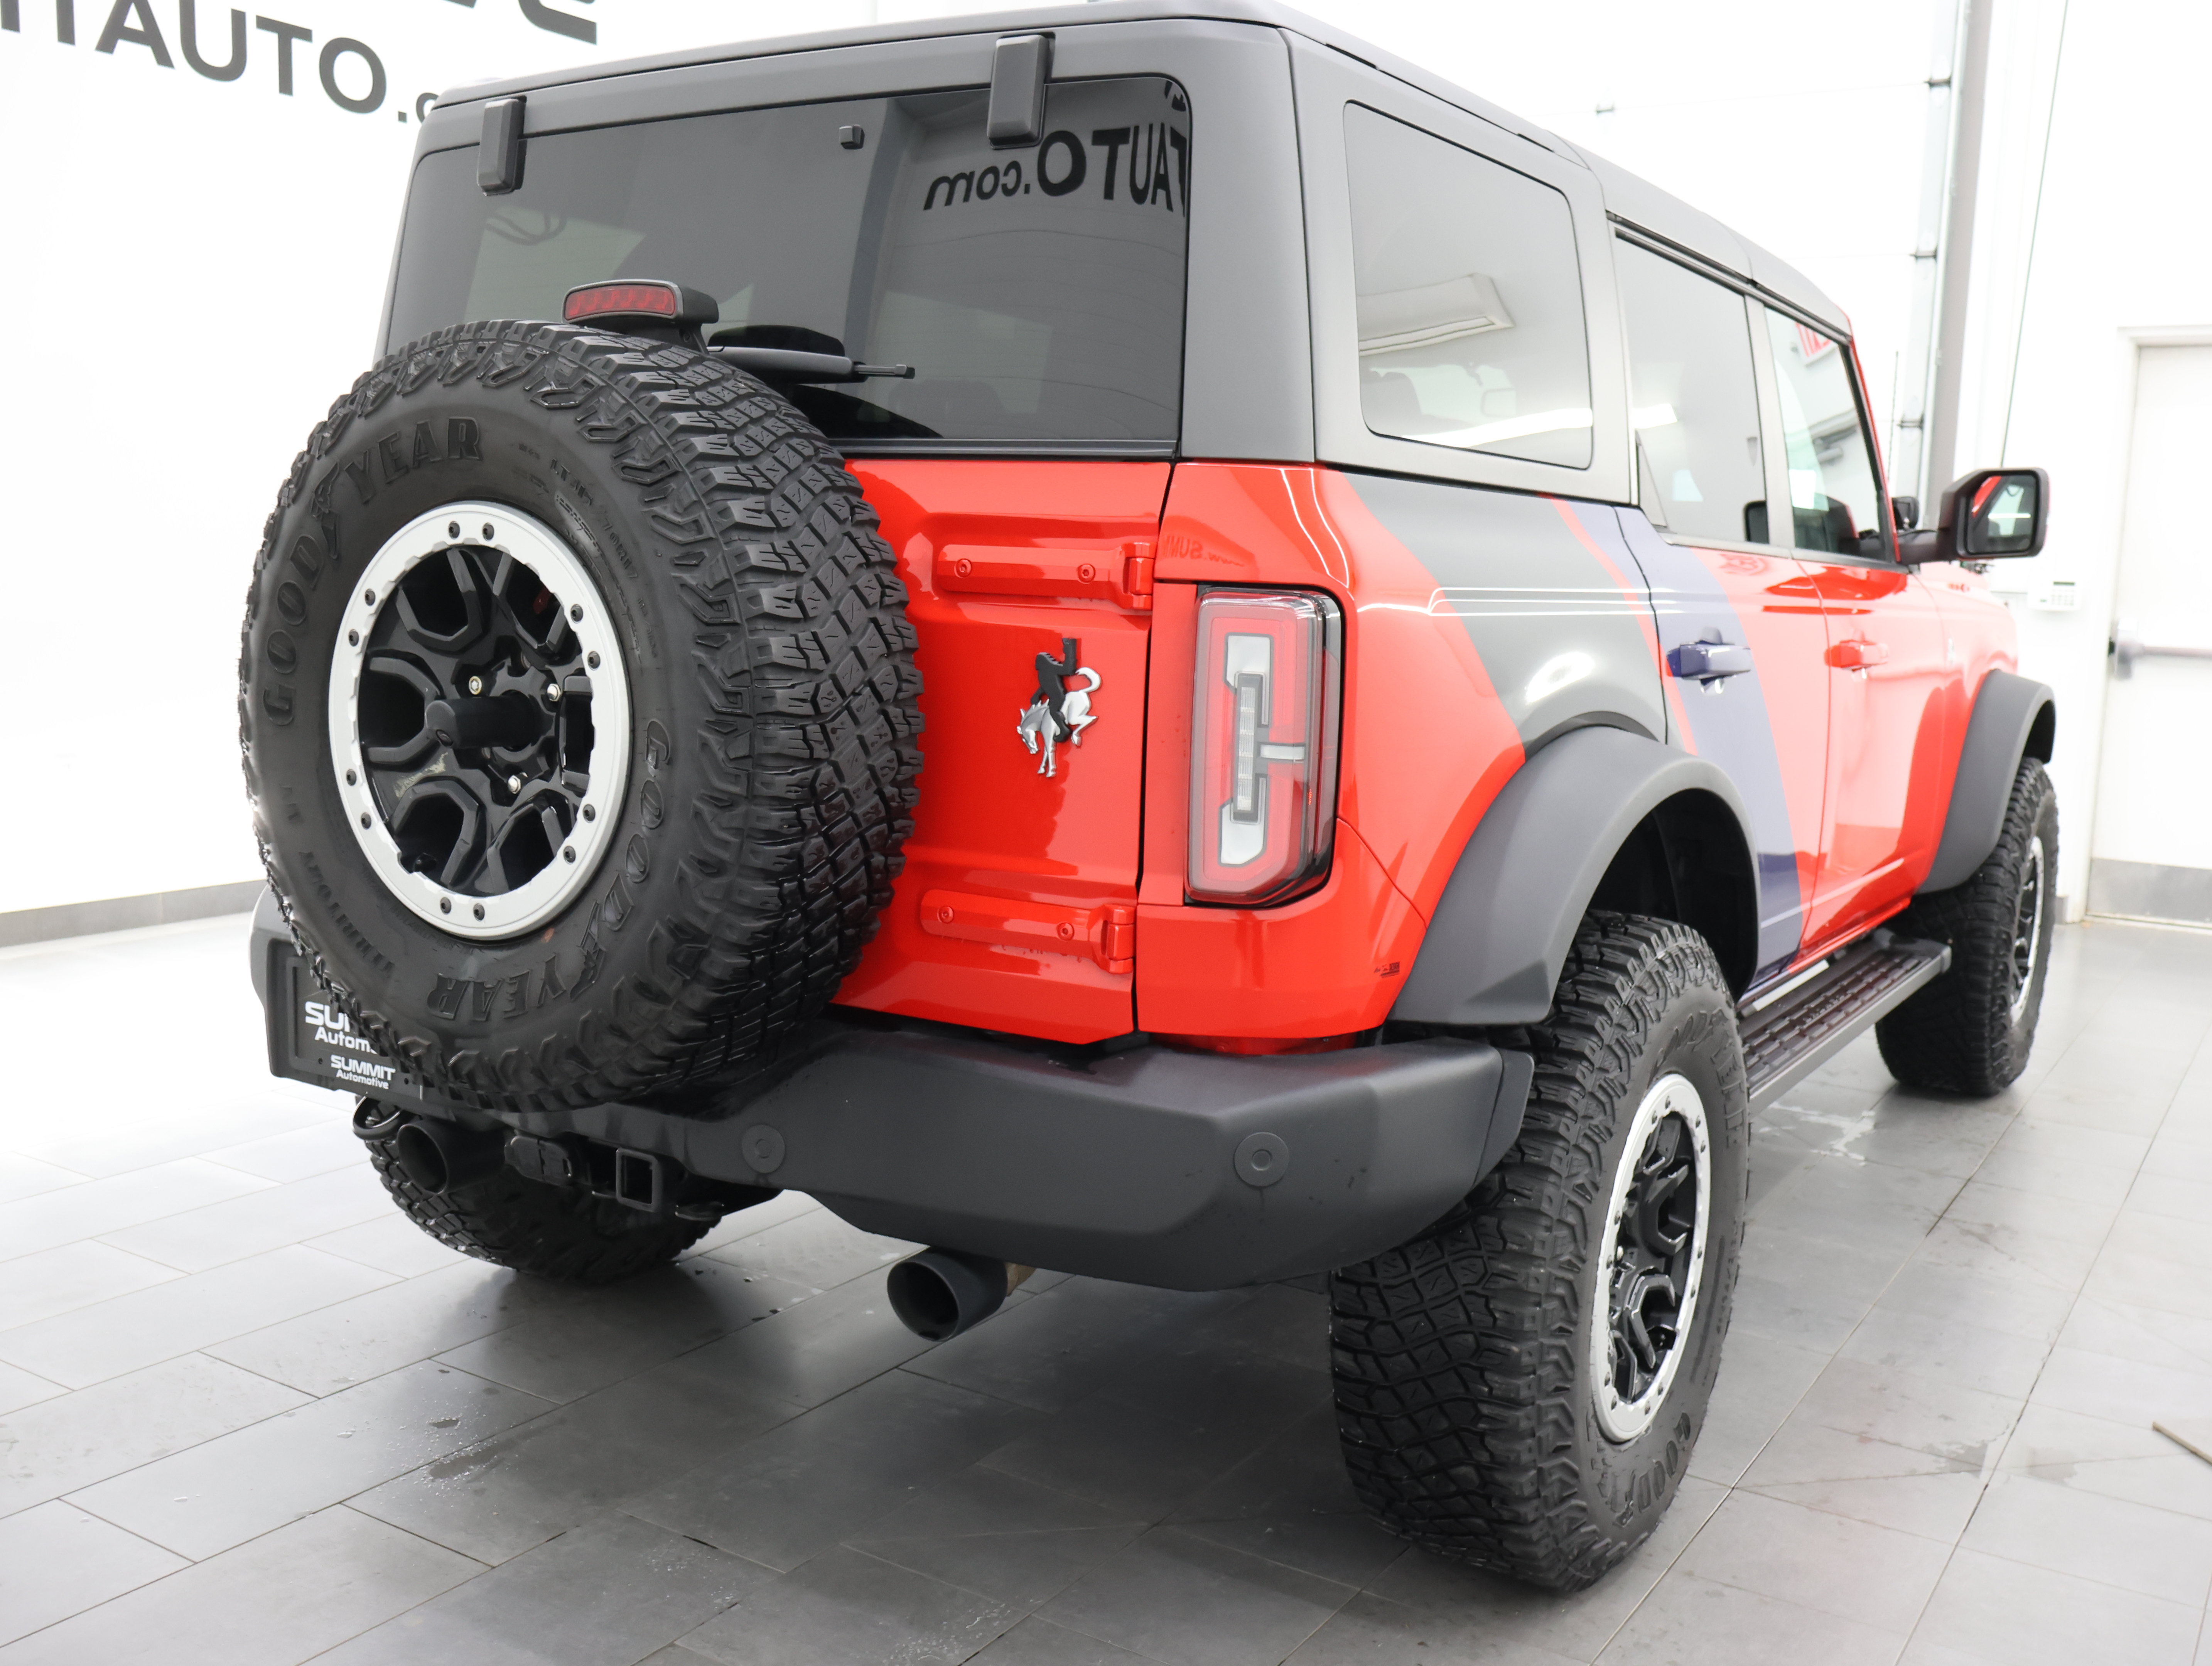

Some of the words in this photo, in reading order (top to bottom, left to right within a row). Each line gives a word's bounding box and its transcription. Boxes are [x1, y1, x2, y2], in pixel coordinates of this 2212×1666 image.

[263, 416, 483, 725] GOODYEAR
[426, 719, 671, 1021] GOODYEAR
[315, 1026, 378, 1055] Autom
[331, 1054, 396, 1081] SUMMIT
[336, 1069, 389, 1089] Automotive
